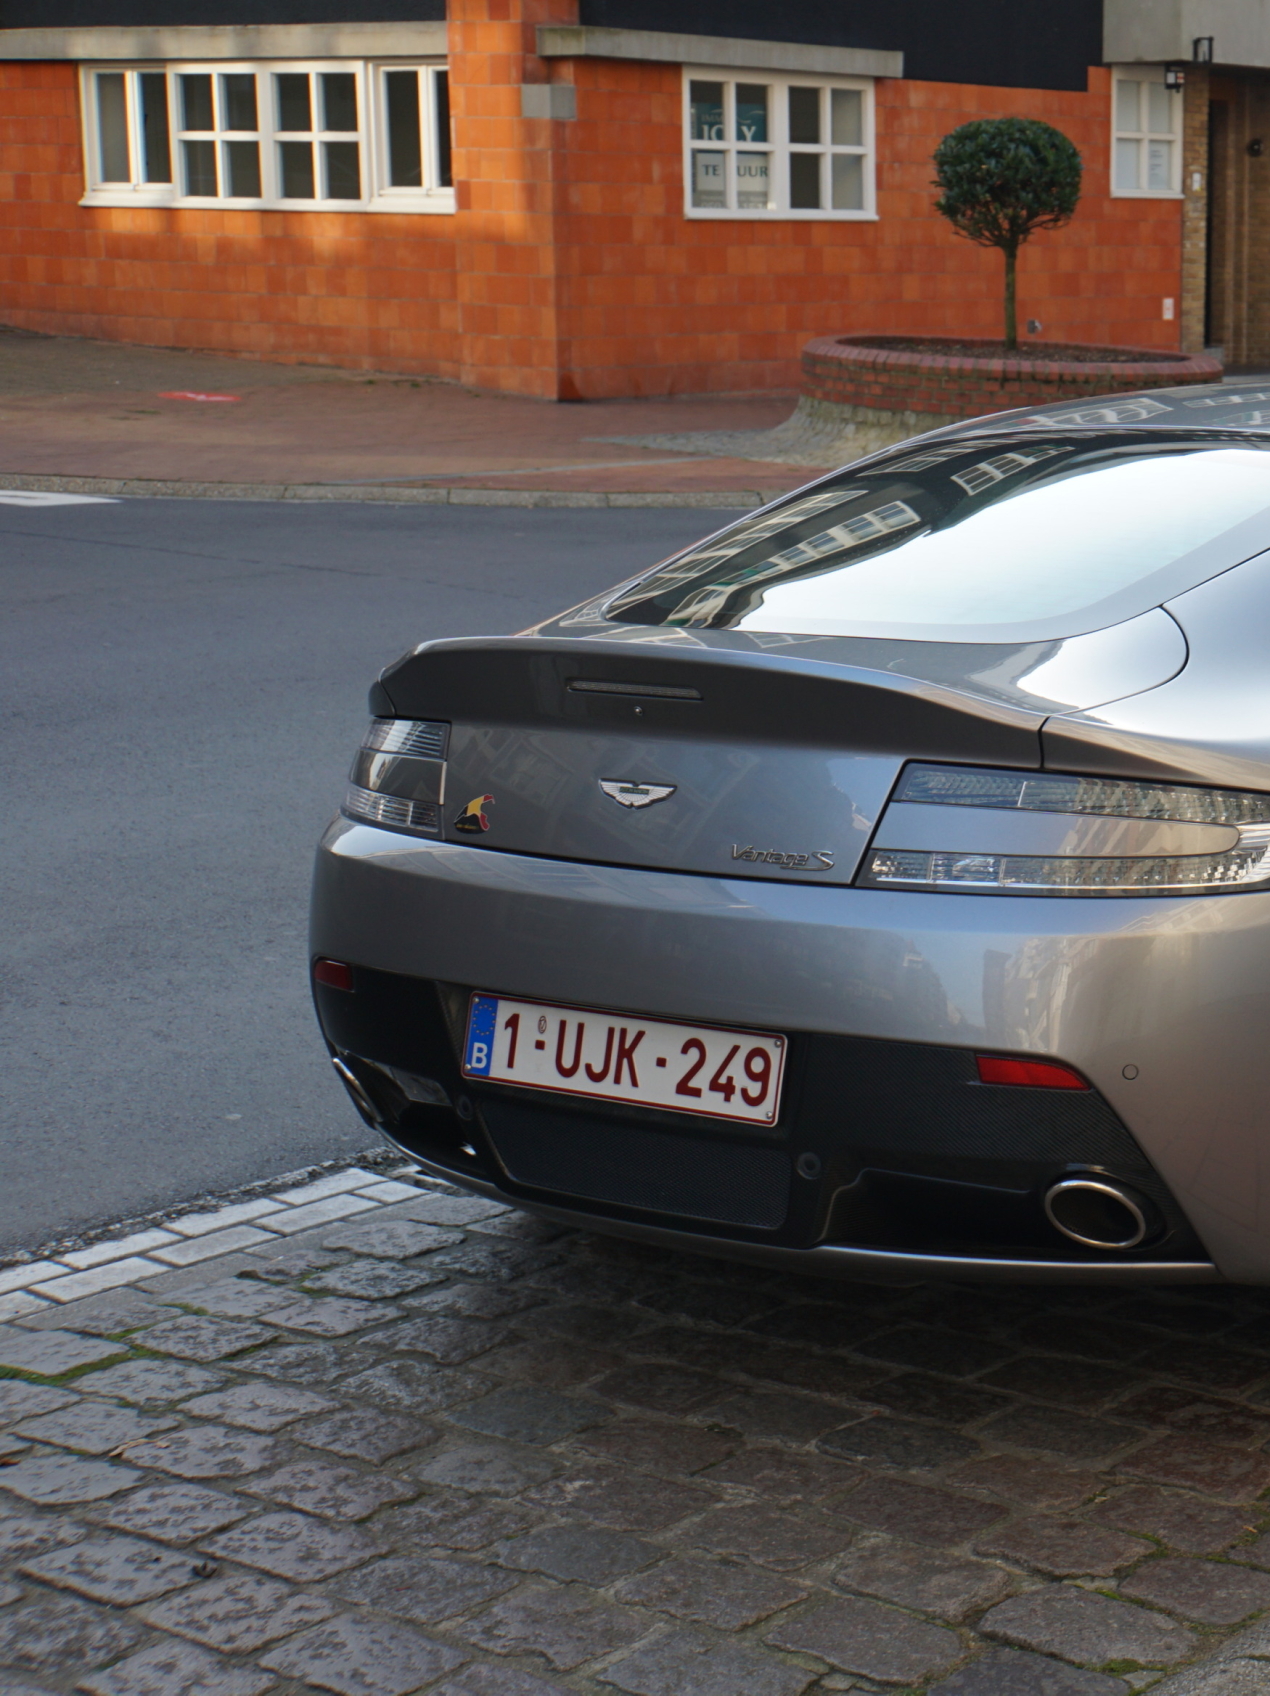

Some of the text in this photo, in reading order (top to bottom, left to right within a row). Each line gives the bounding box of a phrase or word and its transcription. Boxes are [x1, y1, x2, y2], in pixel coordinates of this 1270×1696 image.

[702, 164, 720, 176] TE
[732, 844, 808, 867] Vantage
[470, 1042, 488, 1069] B
[504, 1013, 772, 1106] 1-UJK-249
